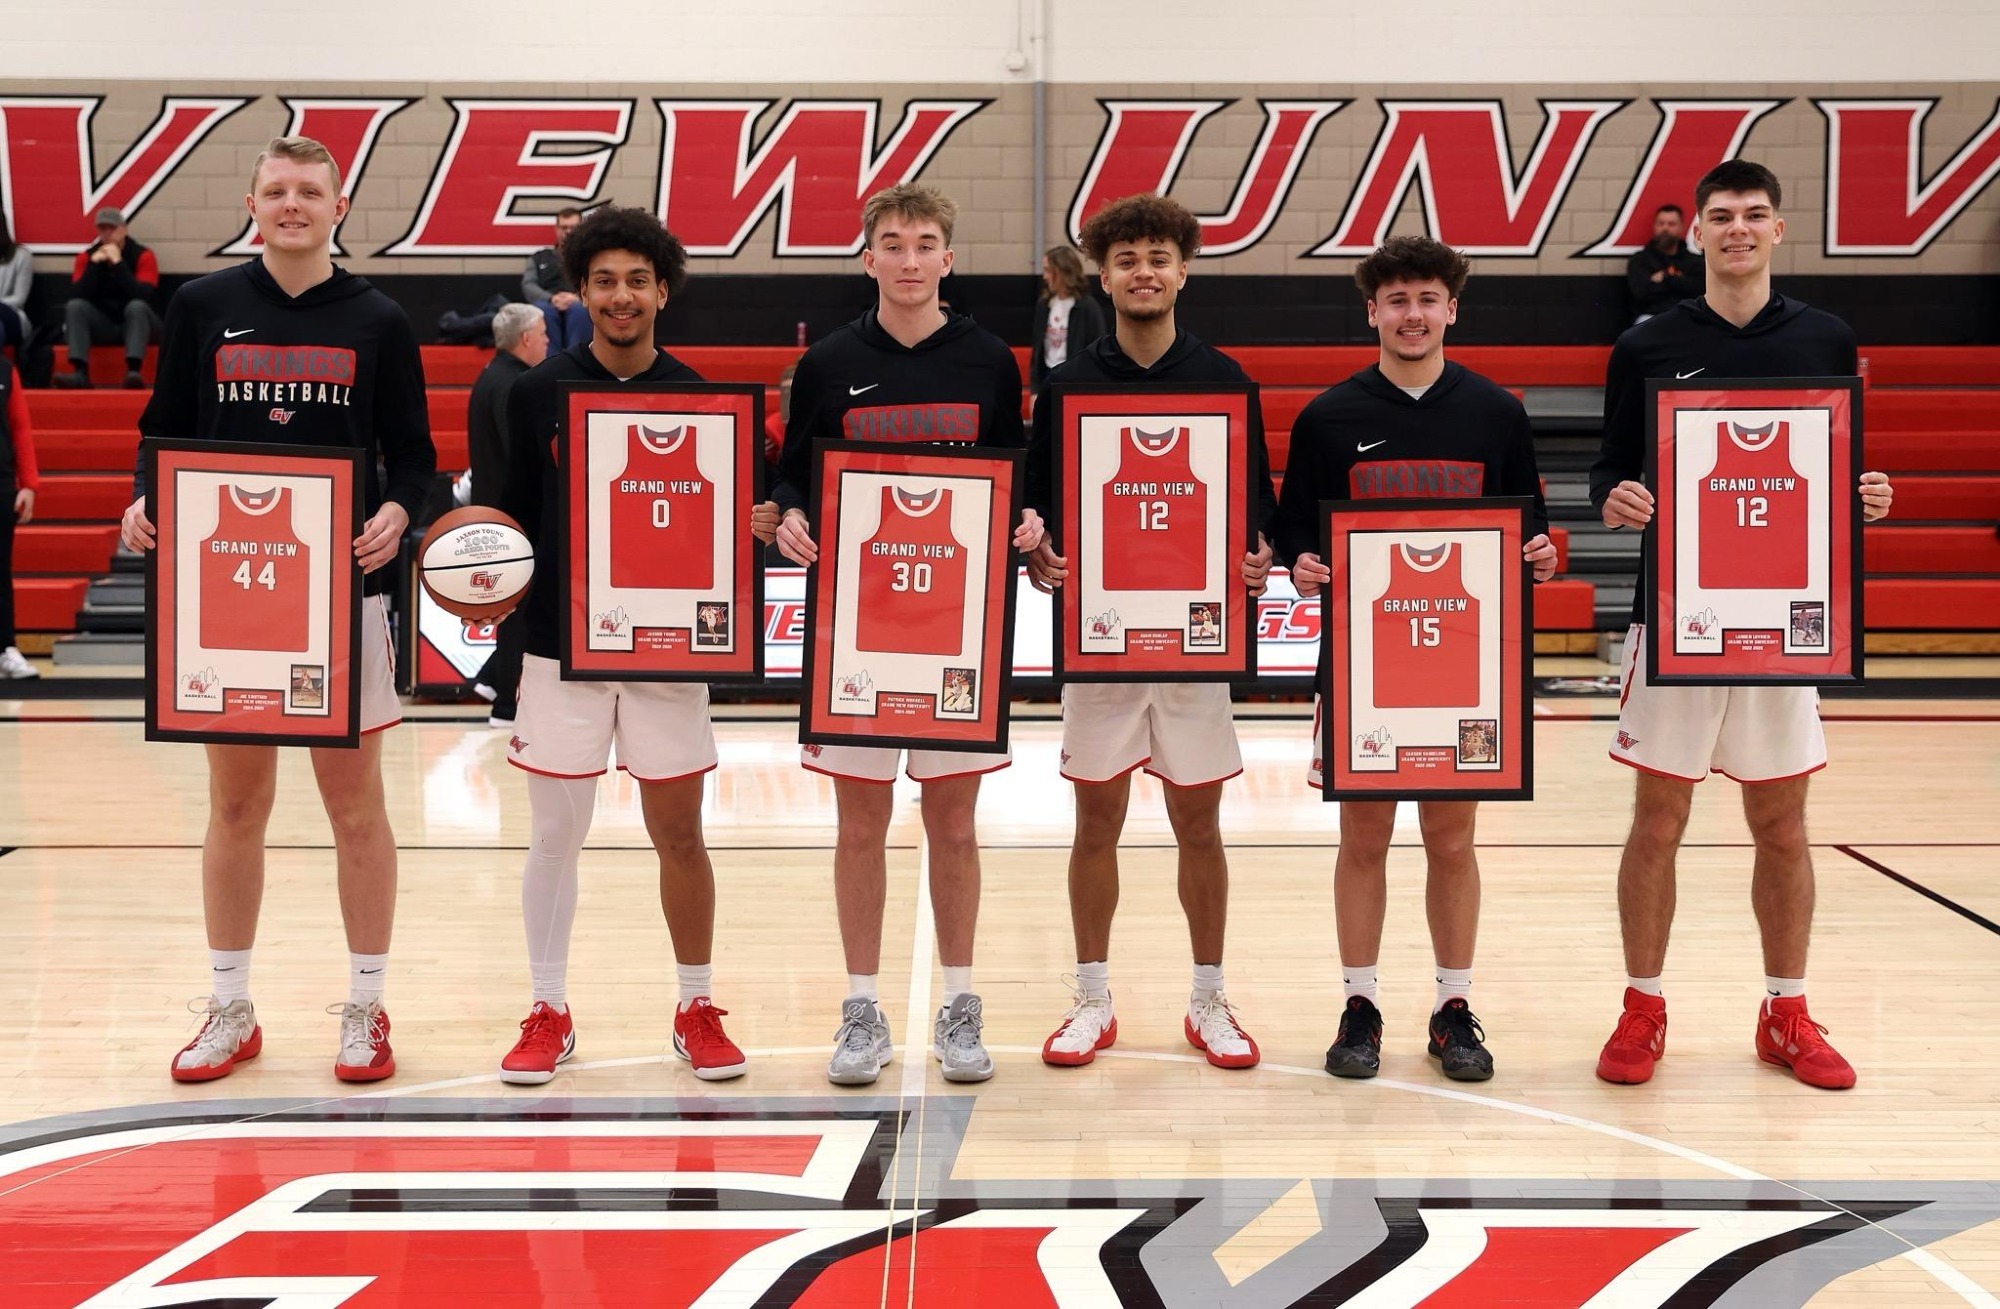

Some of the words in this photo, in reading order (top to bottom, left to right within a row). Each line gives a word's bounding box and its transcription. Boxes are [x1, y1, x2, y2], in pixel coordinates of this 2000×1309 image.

[0, 97, 994, 258] VIEW
[219, 348, 350, 379] VIKINGS
[217, 382, 350, 406] BASKETBALL
[268, 407, 296, 425] GV
[847, 407, 976, 440] VIKINGS
[621, 480, 665, 494] GRAND
[670, 481, 702, 494] VIEW
[1113, 482, 1157, 496] GRAND
[1163, 482, 1195, 496] VIEW
[1354, 464, 1482, 495] VIKINGS
[1710, 478, 1756, 491] GRAND
[1762, 478, 1795, 491] VIEW
[652, 499, 670, 528] 0
[1139, 501, 1169, 530] 12
[1736, 496, 1768, 527] 12
[456, 529, 481, 543] JAXSON
[481, 529, 504, 538] YOUNG
[464, 535, 499, 548] 1000
[211, 540, 258, 555] GRAND
[264, 543, 297, 557] VIEW
[872, 542, 917, 557] GRAND
[922, 545, 955, 558] VIEW
[232, 560, 276, 591] 44
[470, 571, 504, 592] GV
[891, 561, 932, 593] 30
[1383, 599, 1429, 612] GRAND
[1434, 598, 1467, 611] VIEW
[1409, 617, 1440, 647] 15
